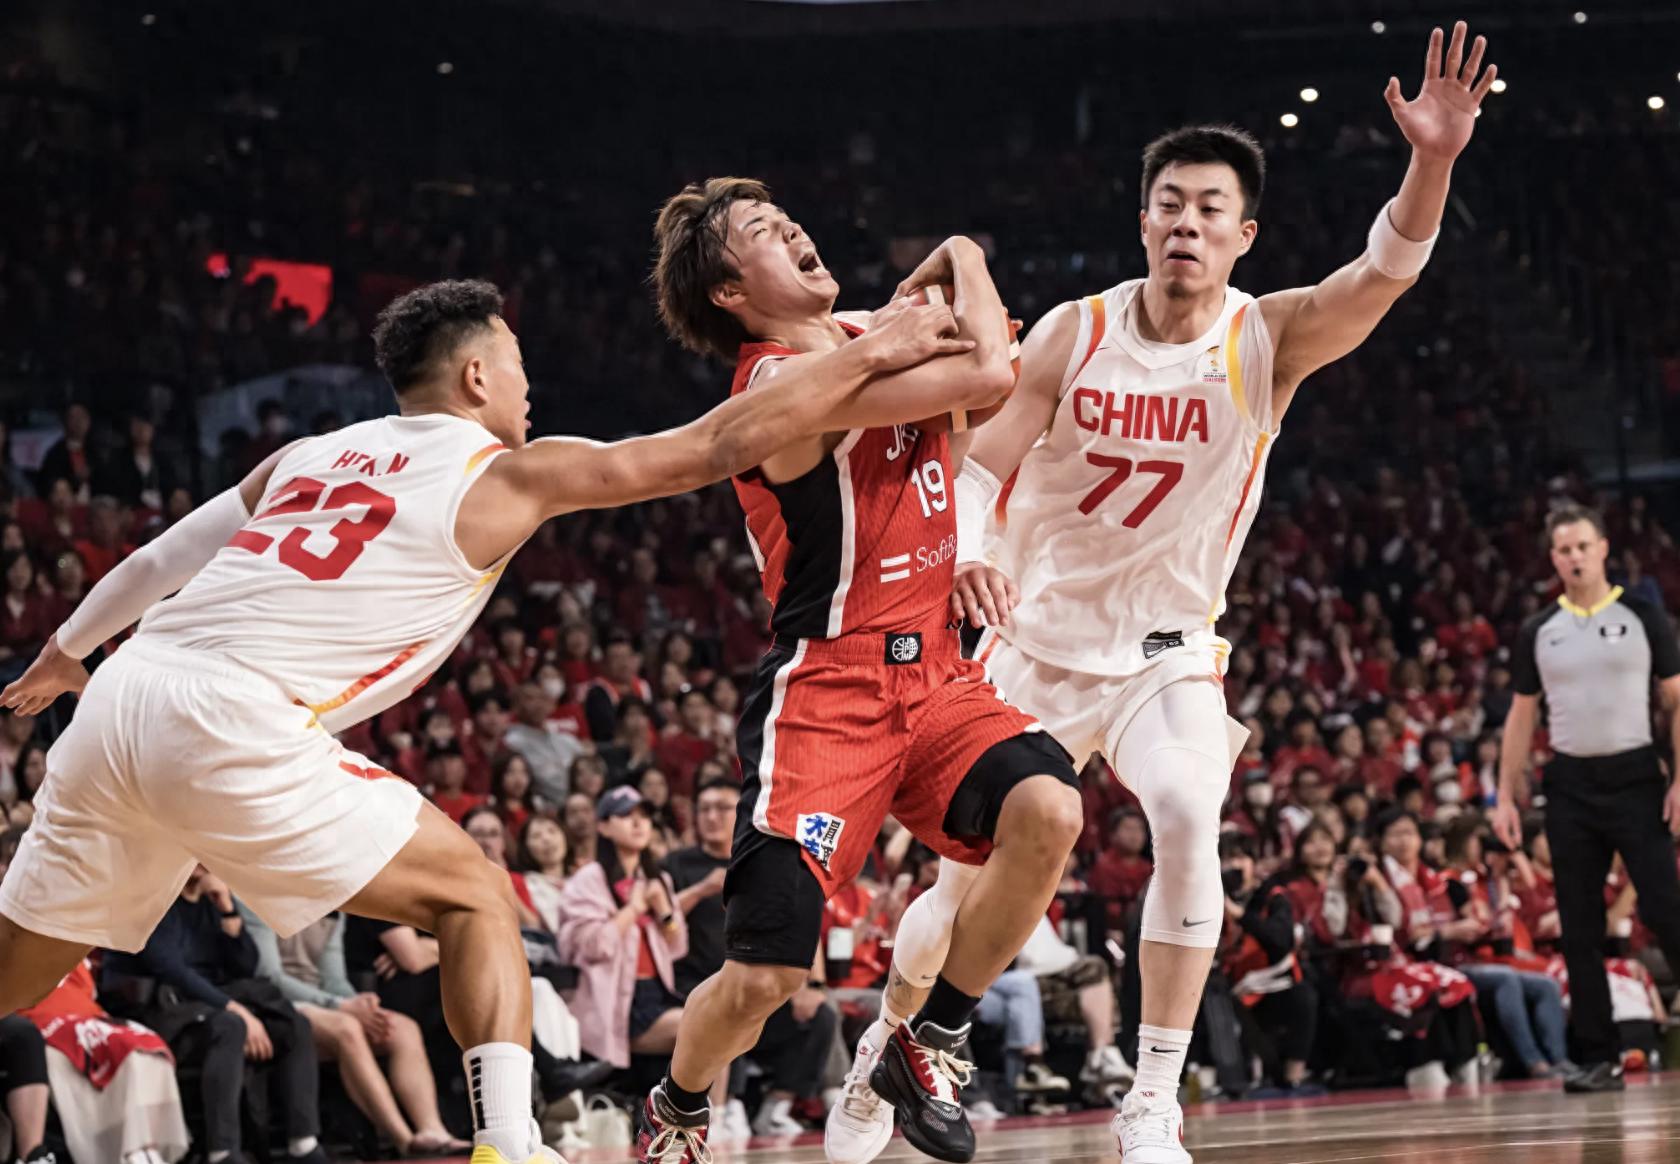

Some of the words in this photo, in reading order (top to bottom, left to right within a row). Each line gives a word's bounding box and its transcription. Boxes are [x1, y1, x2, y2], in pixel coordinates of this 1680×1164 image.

[1073, 386, 1209, 443] CHINA
[911, 459, 948, 518] 19
[1078, 452, 1185, 529] 77
[223, 476, 397, 581] 23
